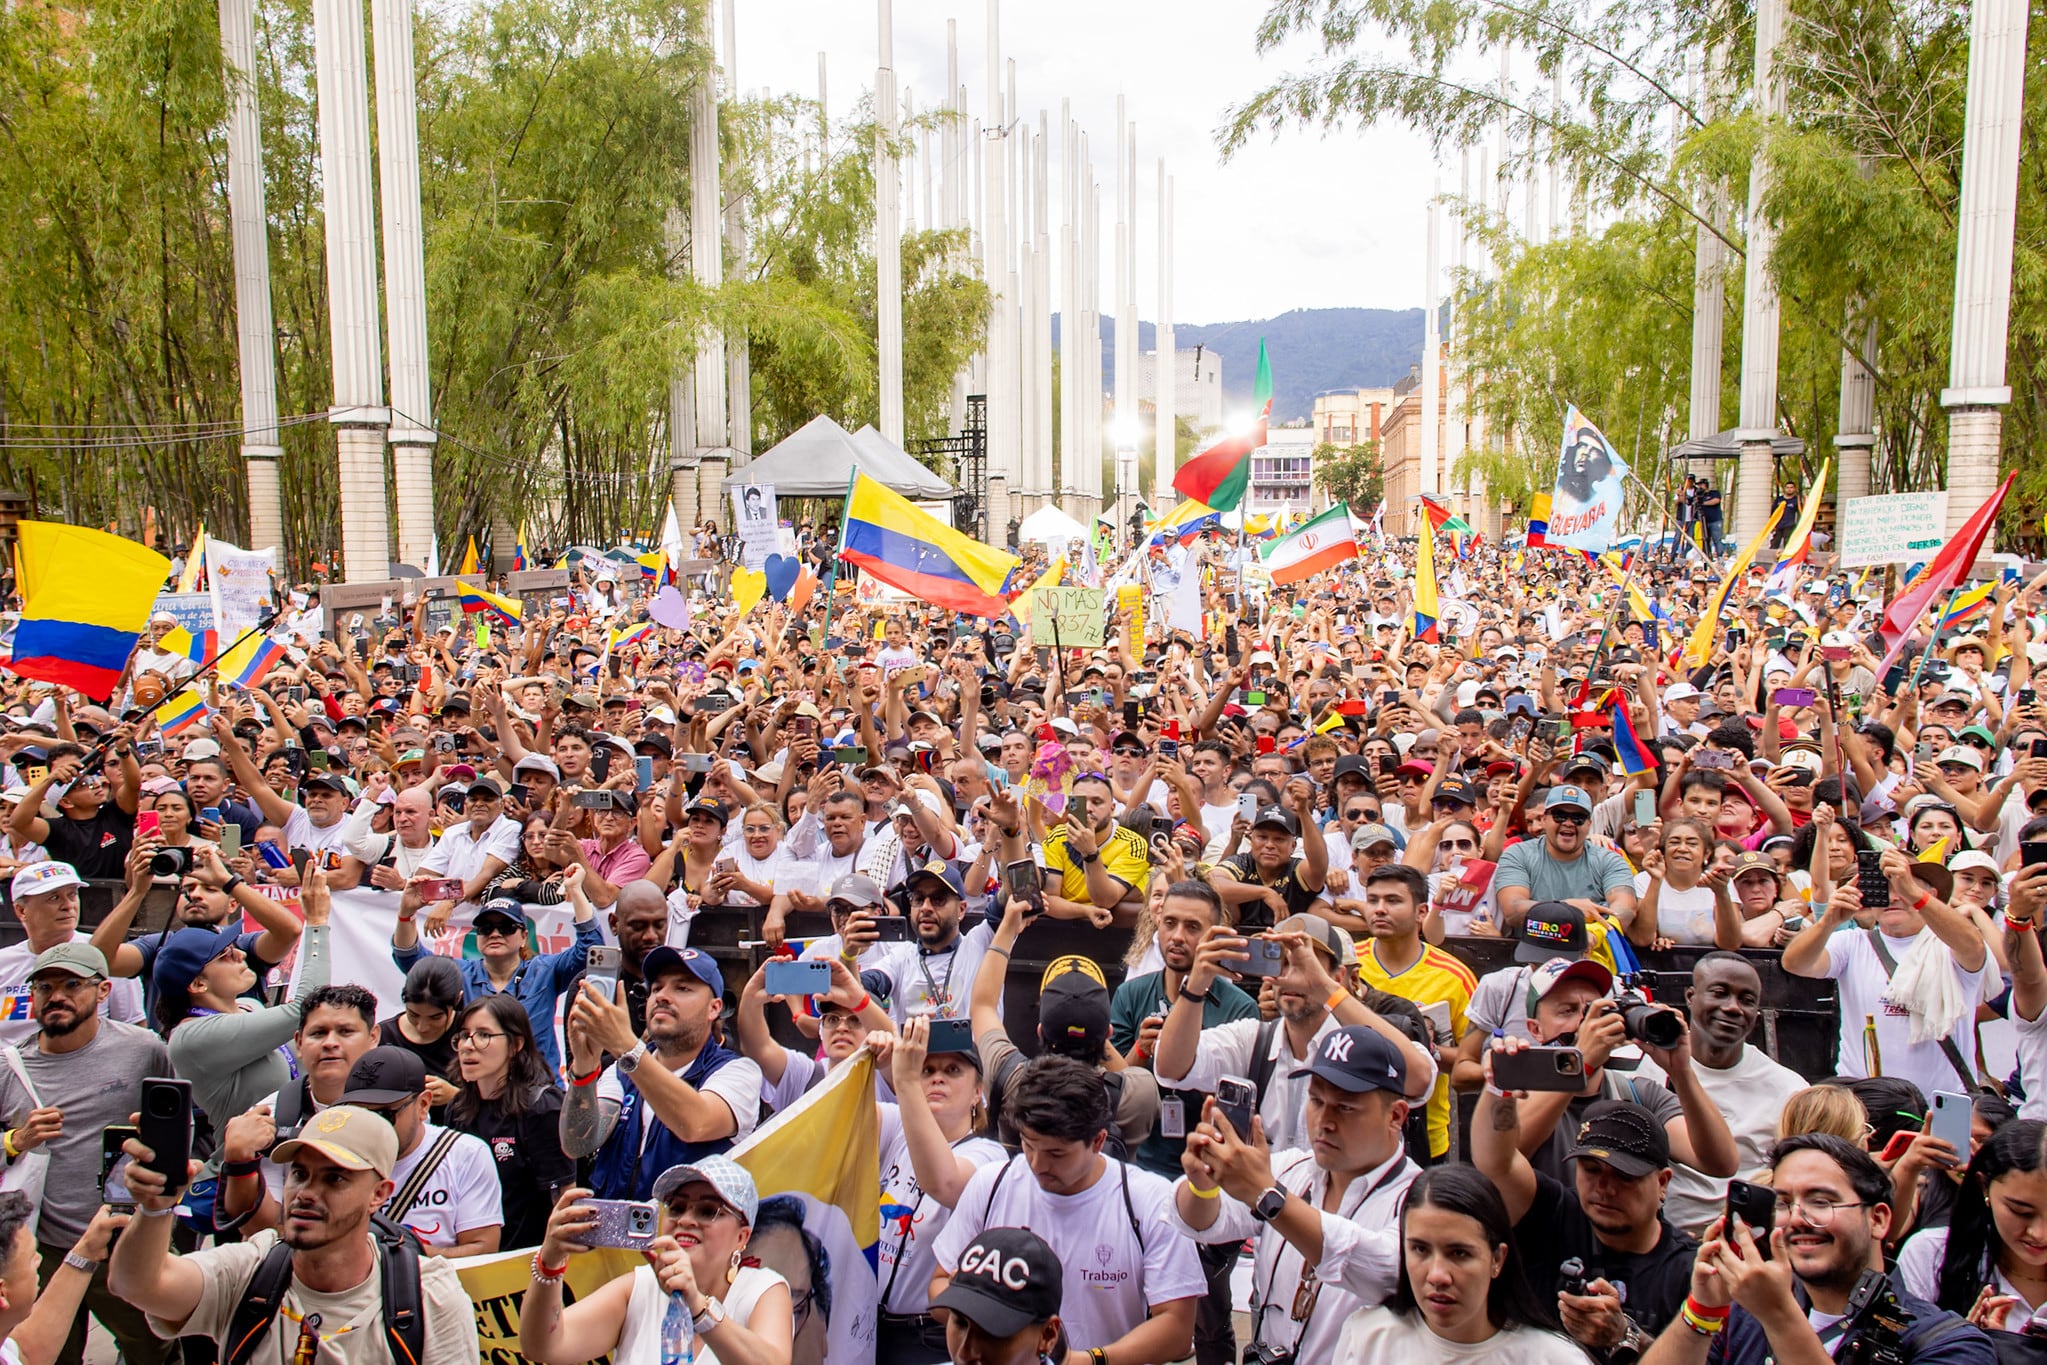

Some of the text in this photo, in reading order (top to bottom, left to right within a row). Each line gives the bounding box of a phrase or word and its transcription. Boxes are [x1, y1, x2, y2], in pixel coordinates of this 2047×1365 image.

[1901, 504, 1929, 512] DIGNO
[1550, 500, 1607, 537] GUEVARA
[1038, 588, 1098, 611] NO MÁS
[1044, 613, 1090, 635] 7837
[1795, 750, 1807, 763] B
[1527, 919, 1559, 933] PETRO
[960, 1244, 1030, 1292] GAC
[1080, 1268, 1128, 1283] Trabajo
